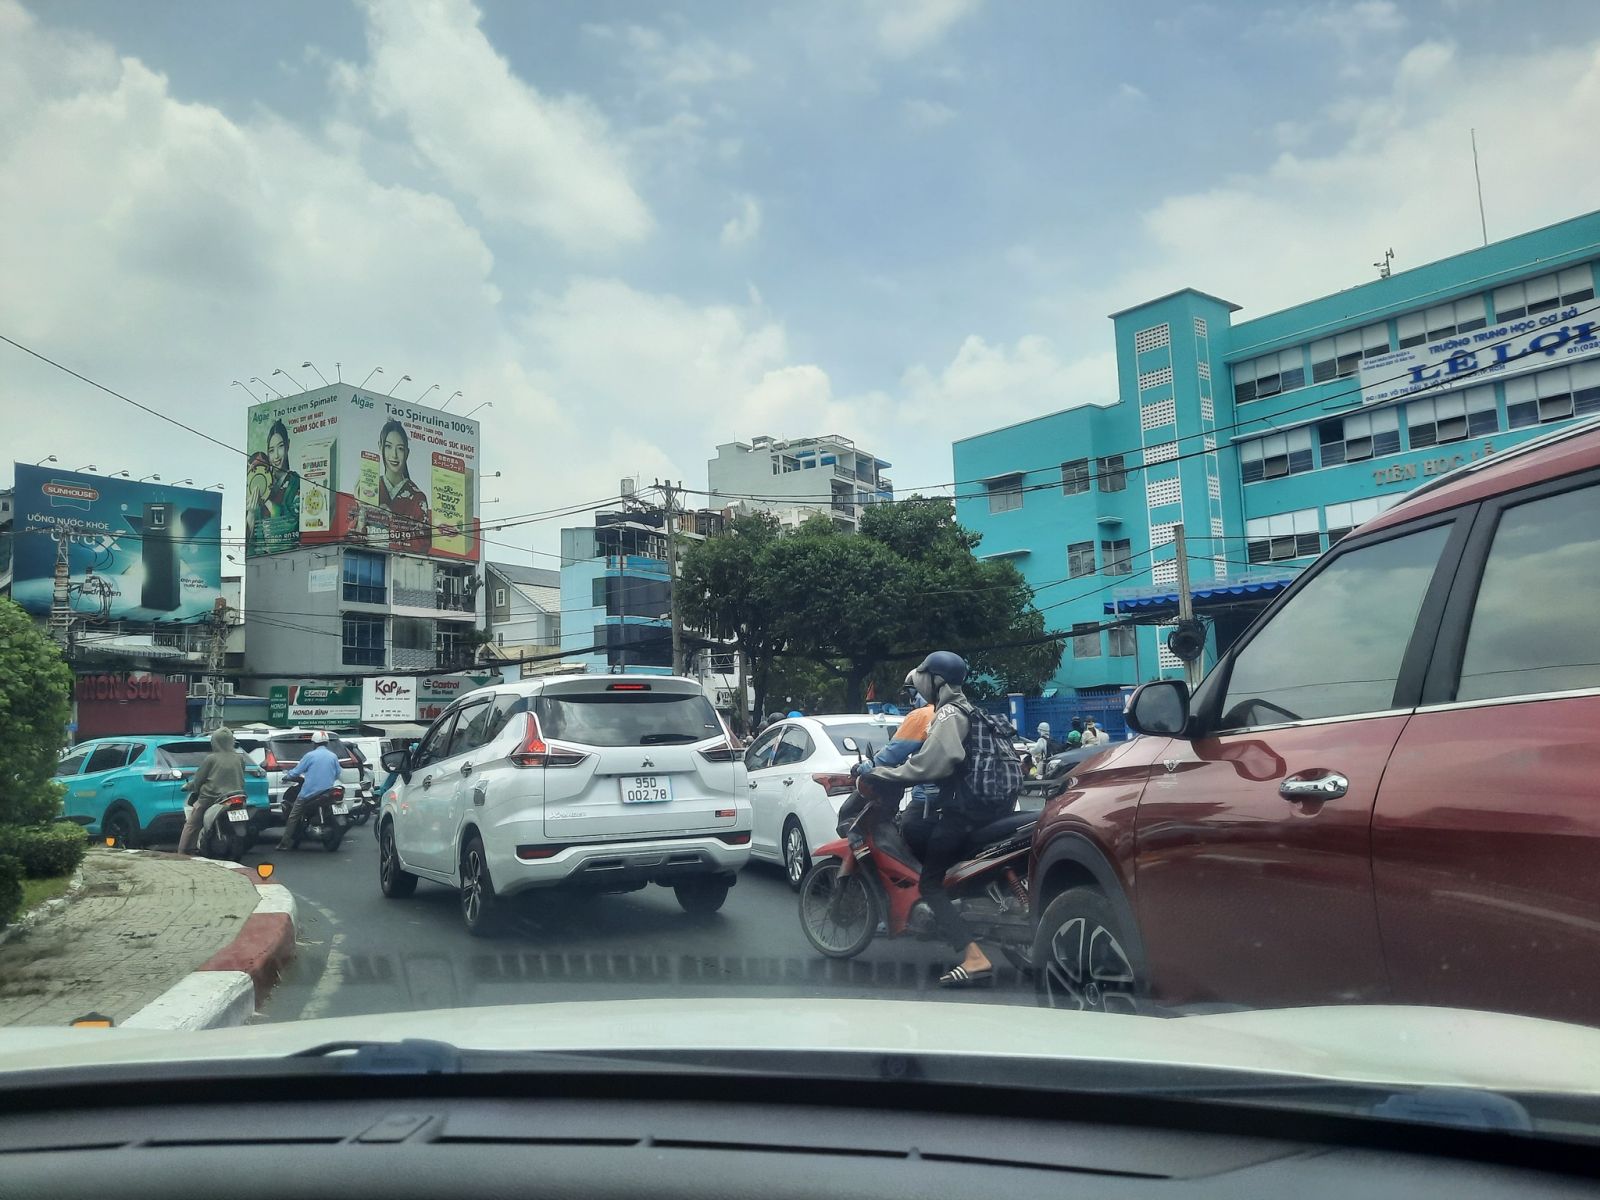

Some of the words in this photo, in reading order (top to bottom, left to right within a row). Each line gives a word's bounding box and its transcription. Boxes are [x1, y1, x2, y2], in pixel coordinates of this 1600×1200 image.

[1473, 327, 1507, 343] TRUNG
[1510, 319, 1536, 334] HỌC
[1539, 314, 1557, 326] CƠ
[1561, 306, 1578, 320] SỞ
[1408, 349, 1479, 384] LÊ
[1491, 321, 1597, 365] LỢI
[406, 409, 450, 429] Spirulina
[451, 421, 475, 436] 100%
[47, 486, 96, 498] SUNHOUSE
[27, 512, 55, 524] UỐNG
[432, 680, 460, 689] Castrol
[635, 777, 657, 789] 95D
[627, 789, 667, 801] 002.78
